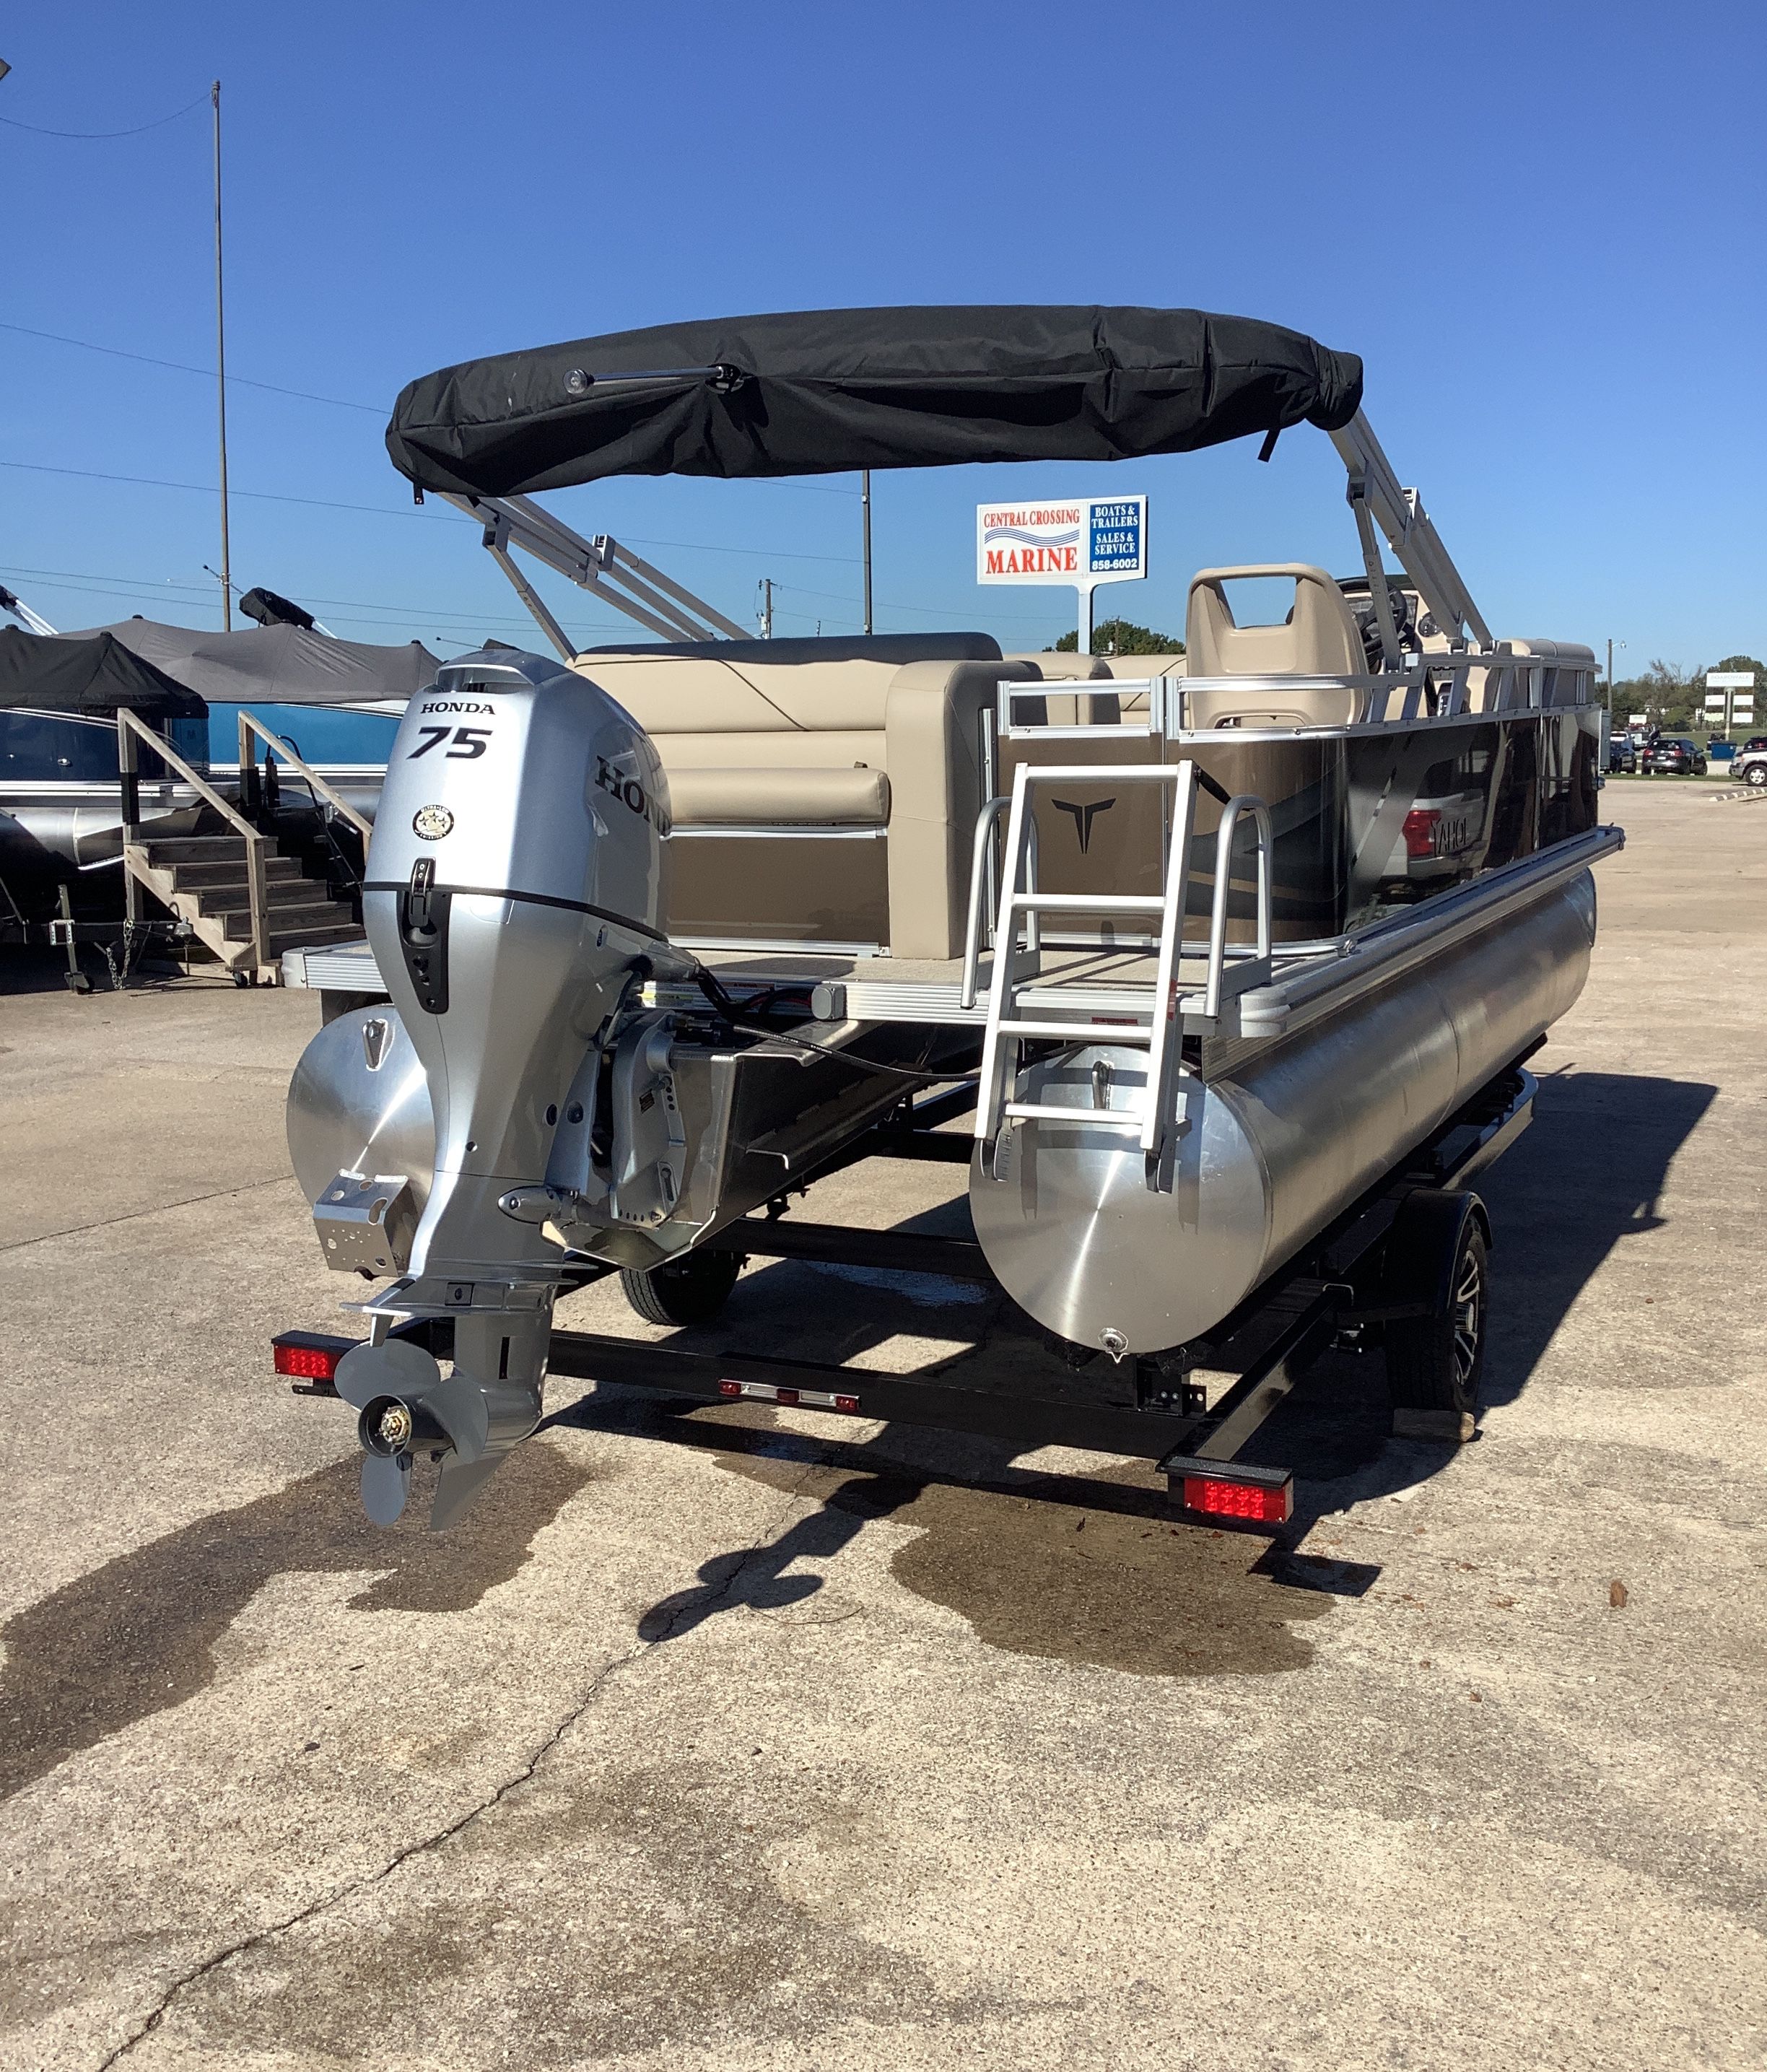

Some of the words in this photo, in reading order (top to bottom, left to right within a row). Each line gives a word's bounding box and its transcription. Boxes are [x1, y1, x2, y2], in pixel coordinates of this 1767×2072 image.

[1095, 505, 1126, 517] BOATS
[1127, 505, 1135, 515] &
[984, 510, 1028, 528] CENTRAL
[1030, 508, 1080, 525] CROSSING
[1091, 515, 1138, 528] TRAILERS
[1096, 532, 1125, 544] SALES
[1127, 532, 1134, 541] &
[1095, 543, 1135, 554] SERVICE
[986, 547, 1078, 574] MARINE
[1091, 558, 1138, 570] 858-6002
[420, 702, 496, 715] HONDA
[406, 726, 494, 760] 75
